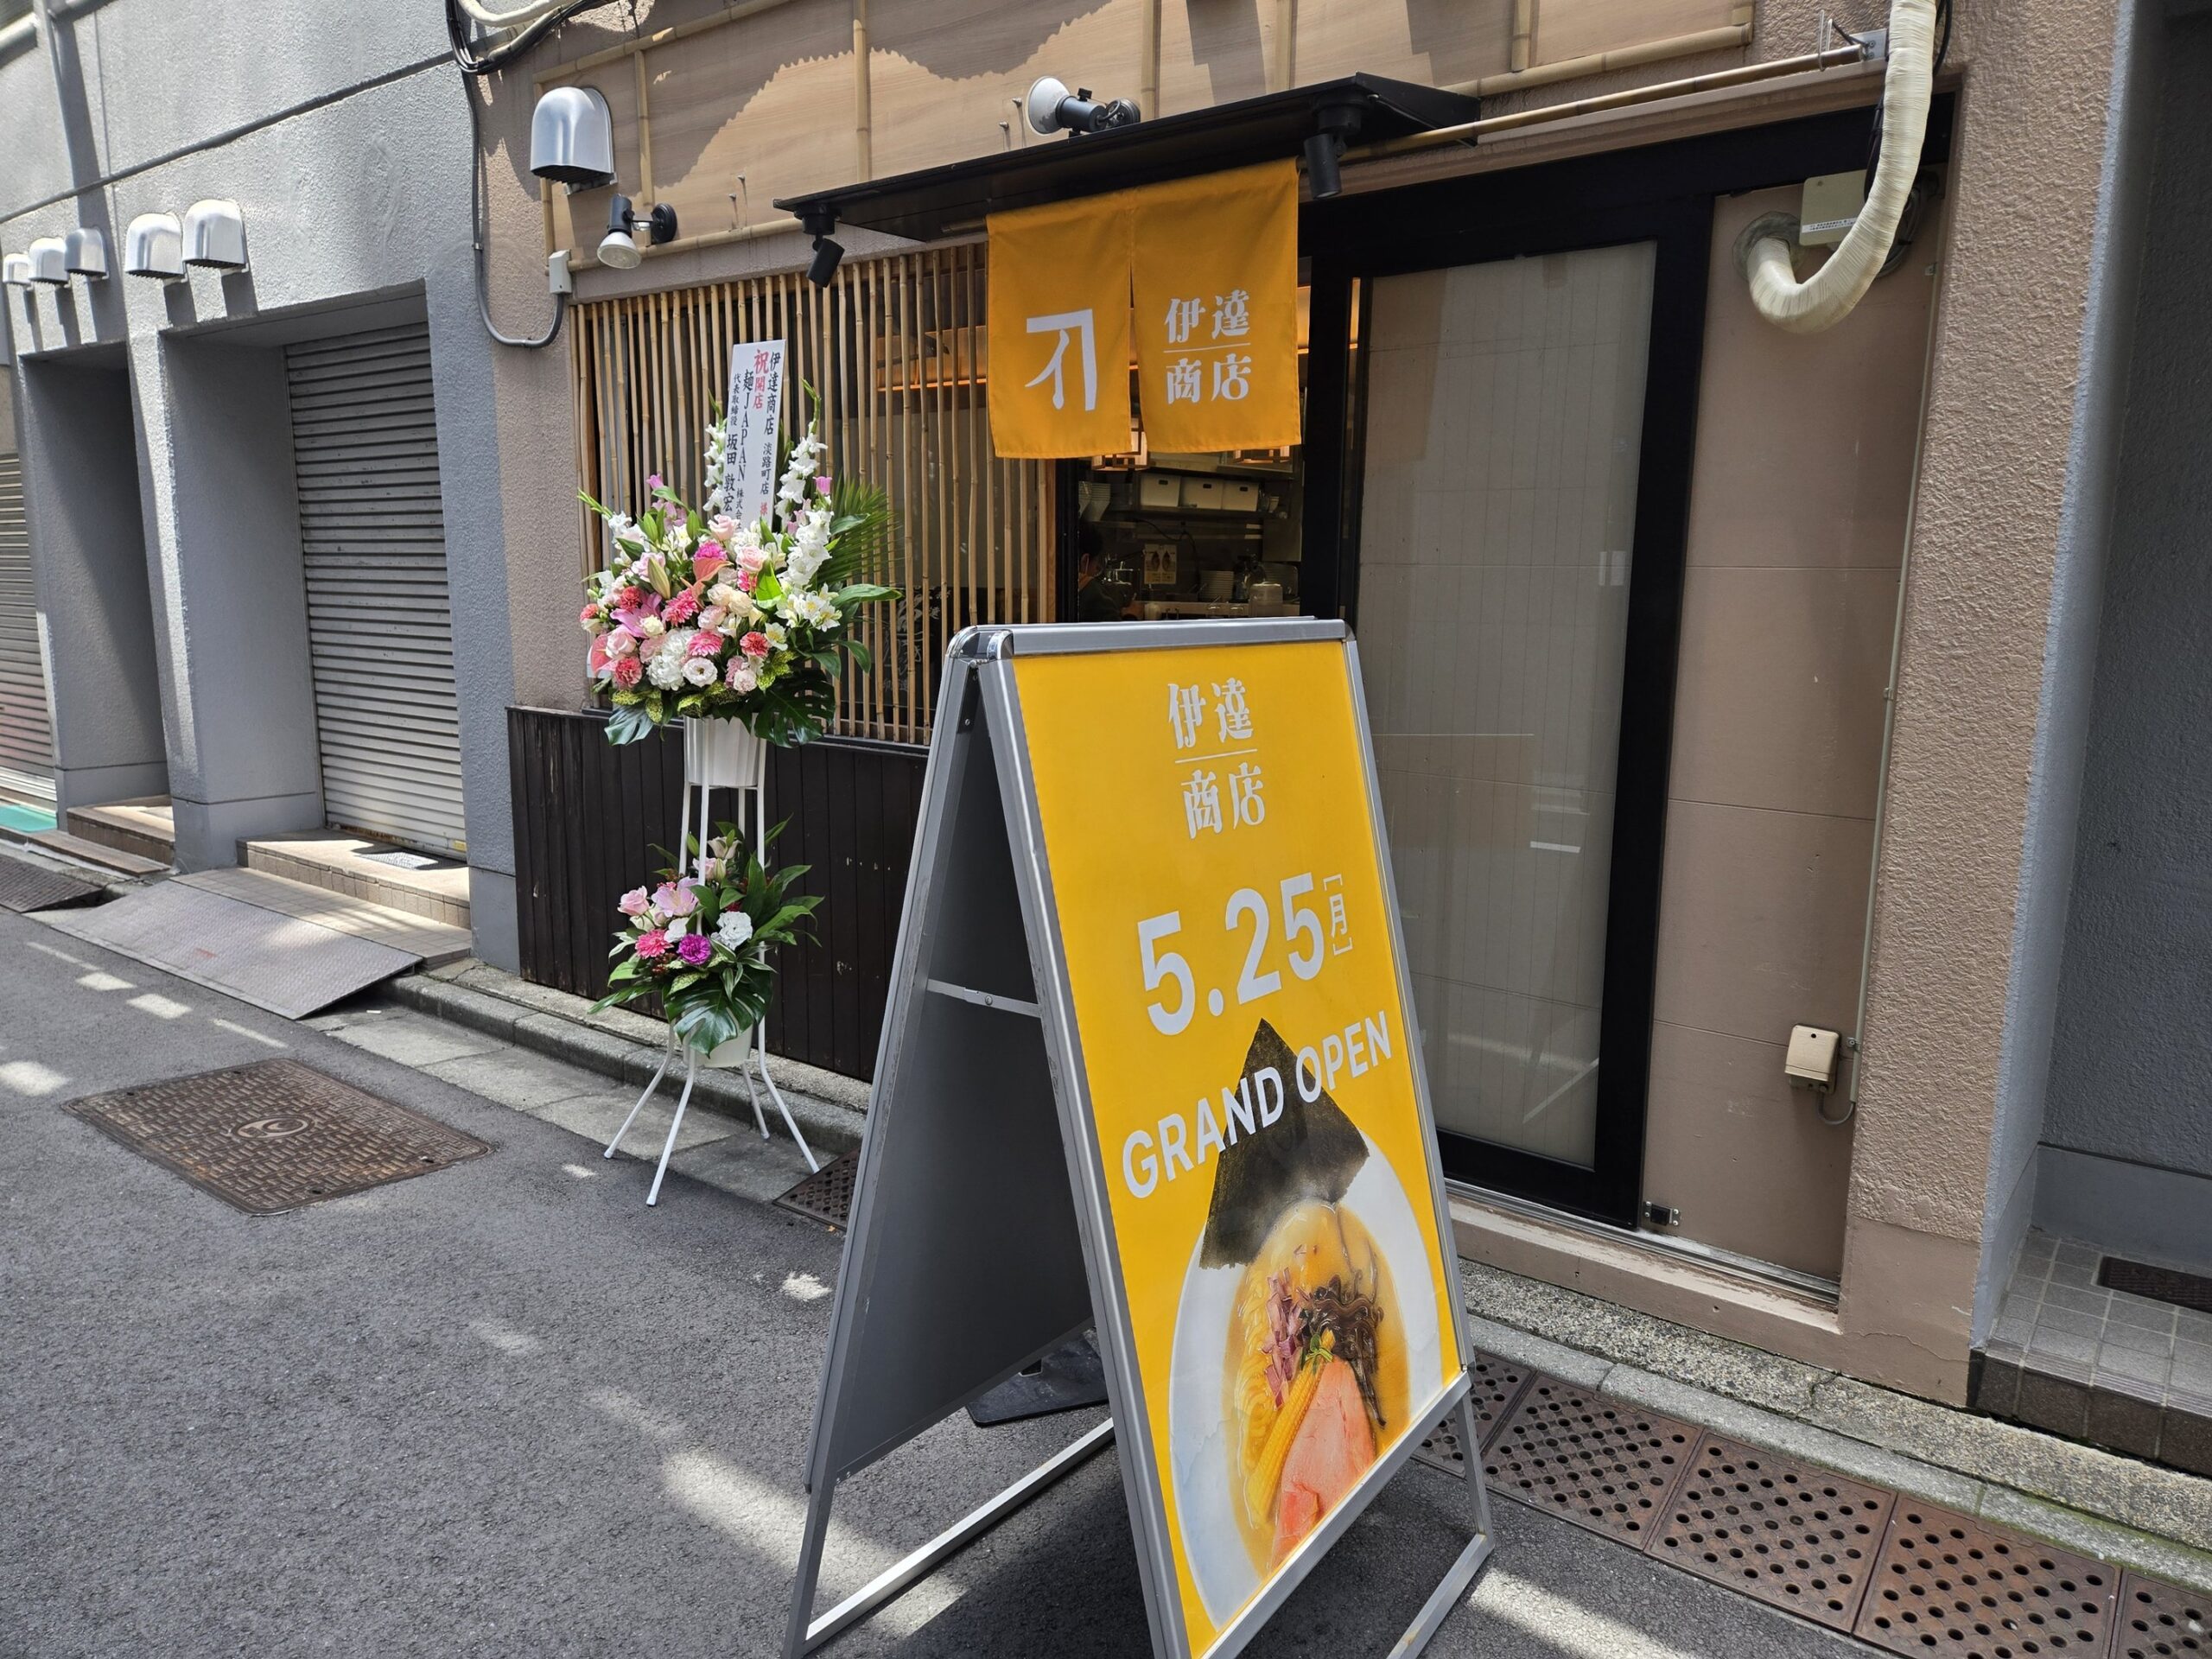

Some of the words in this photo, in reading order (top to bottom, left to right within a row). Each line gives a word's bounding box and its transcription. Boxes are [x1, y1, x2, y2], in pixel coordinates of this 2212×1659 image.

[1163, 289, 1251, 344] 伊達
[765, 351, 781, 435] 伊達商店
[1165, 353, 1252, 404] 商店
[1167, 677, 1255, 749] 伊達
[1180, 761, 1266, 839] 商店
[1136, 872, 1325, 1036] 5.25
[1122, 1066, 1285, 1199] GRAND
[1296, 1010, 1393, 1103] OPEN
